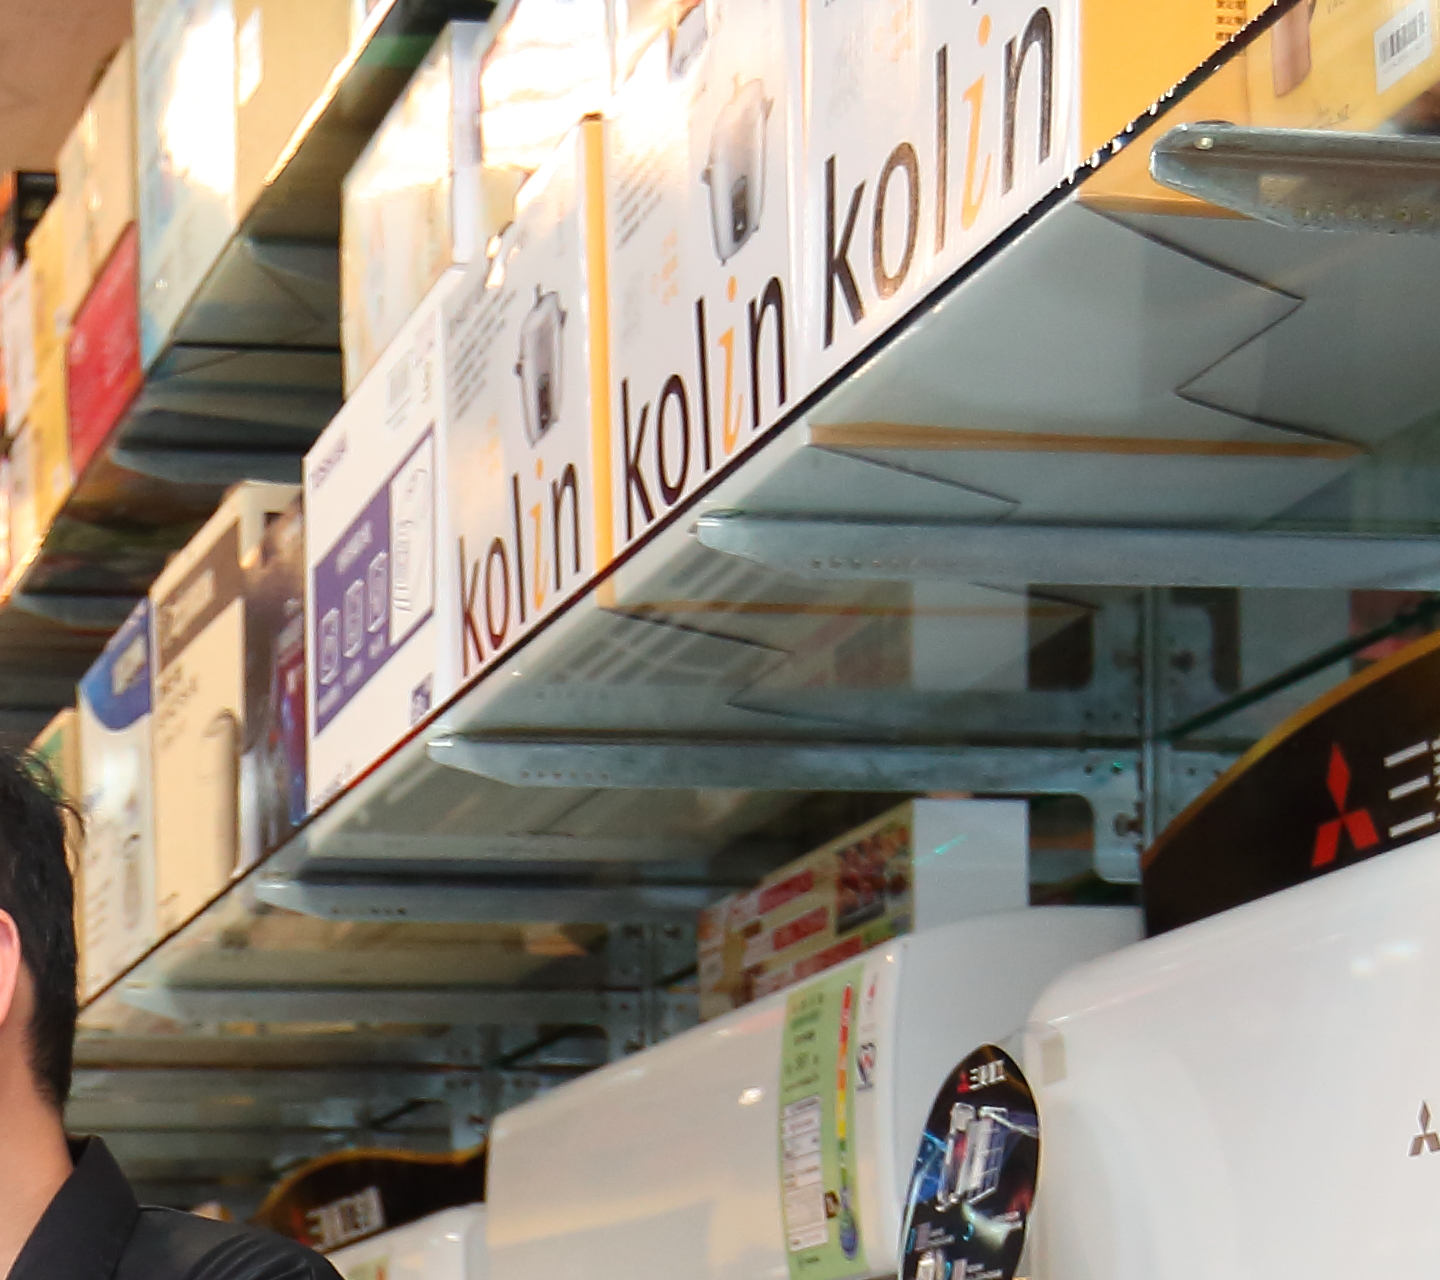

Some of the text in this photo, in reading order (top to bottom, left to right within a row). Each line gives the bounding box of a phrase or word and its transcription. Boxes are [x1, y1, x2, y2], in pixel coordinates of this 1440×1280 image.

[823, 5, 1054, 350] kolin
[620, 275, 788, 542] kolin
[458, 457, 582, 680] kolin
